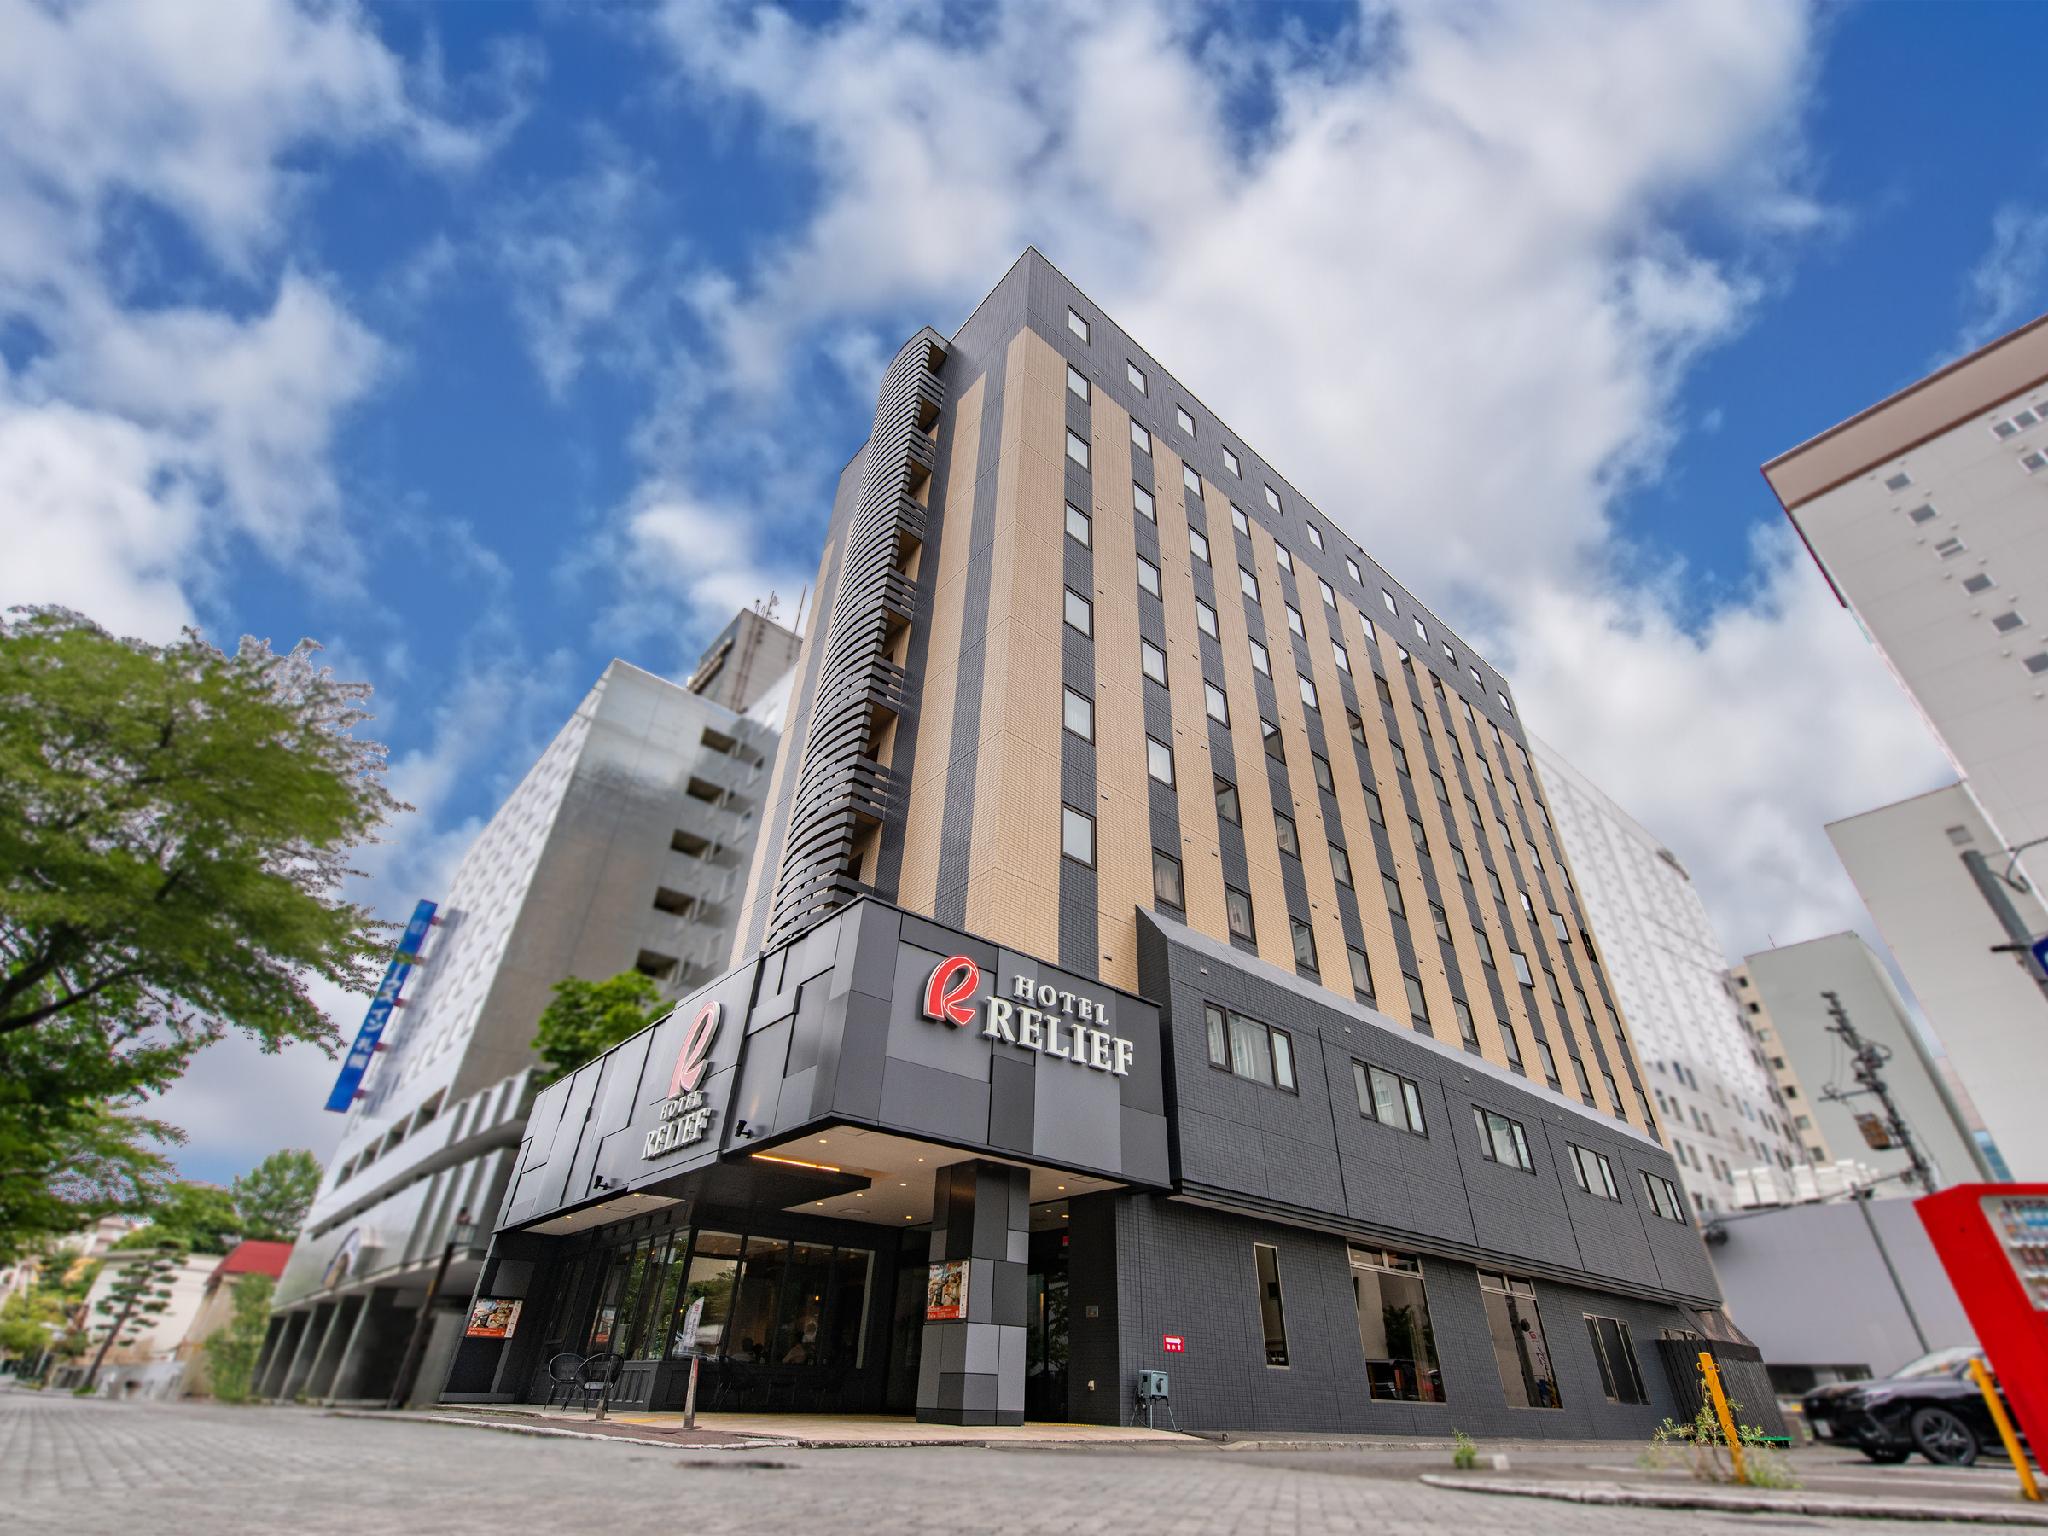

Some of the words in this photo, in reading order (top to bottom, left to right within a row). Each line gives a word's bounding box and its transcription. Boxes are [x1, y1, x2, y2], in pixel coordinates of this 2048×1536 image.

[1014, 974, 1109, 1026] HOTEL
[982, 995, 1134, 1076] RELIEF
[660, 1091, 703, 1121] HOTEL
[641, 1108, 712, 1160] RELIEF
